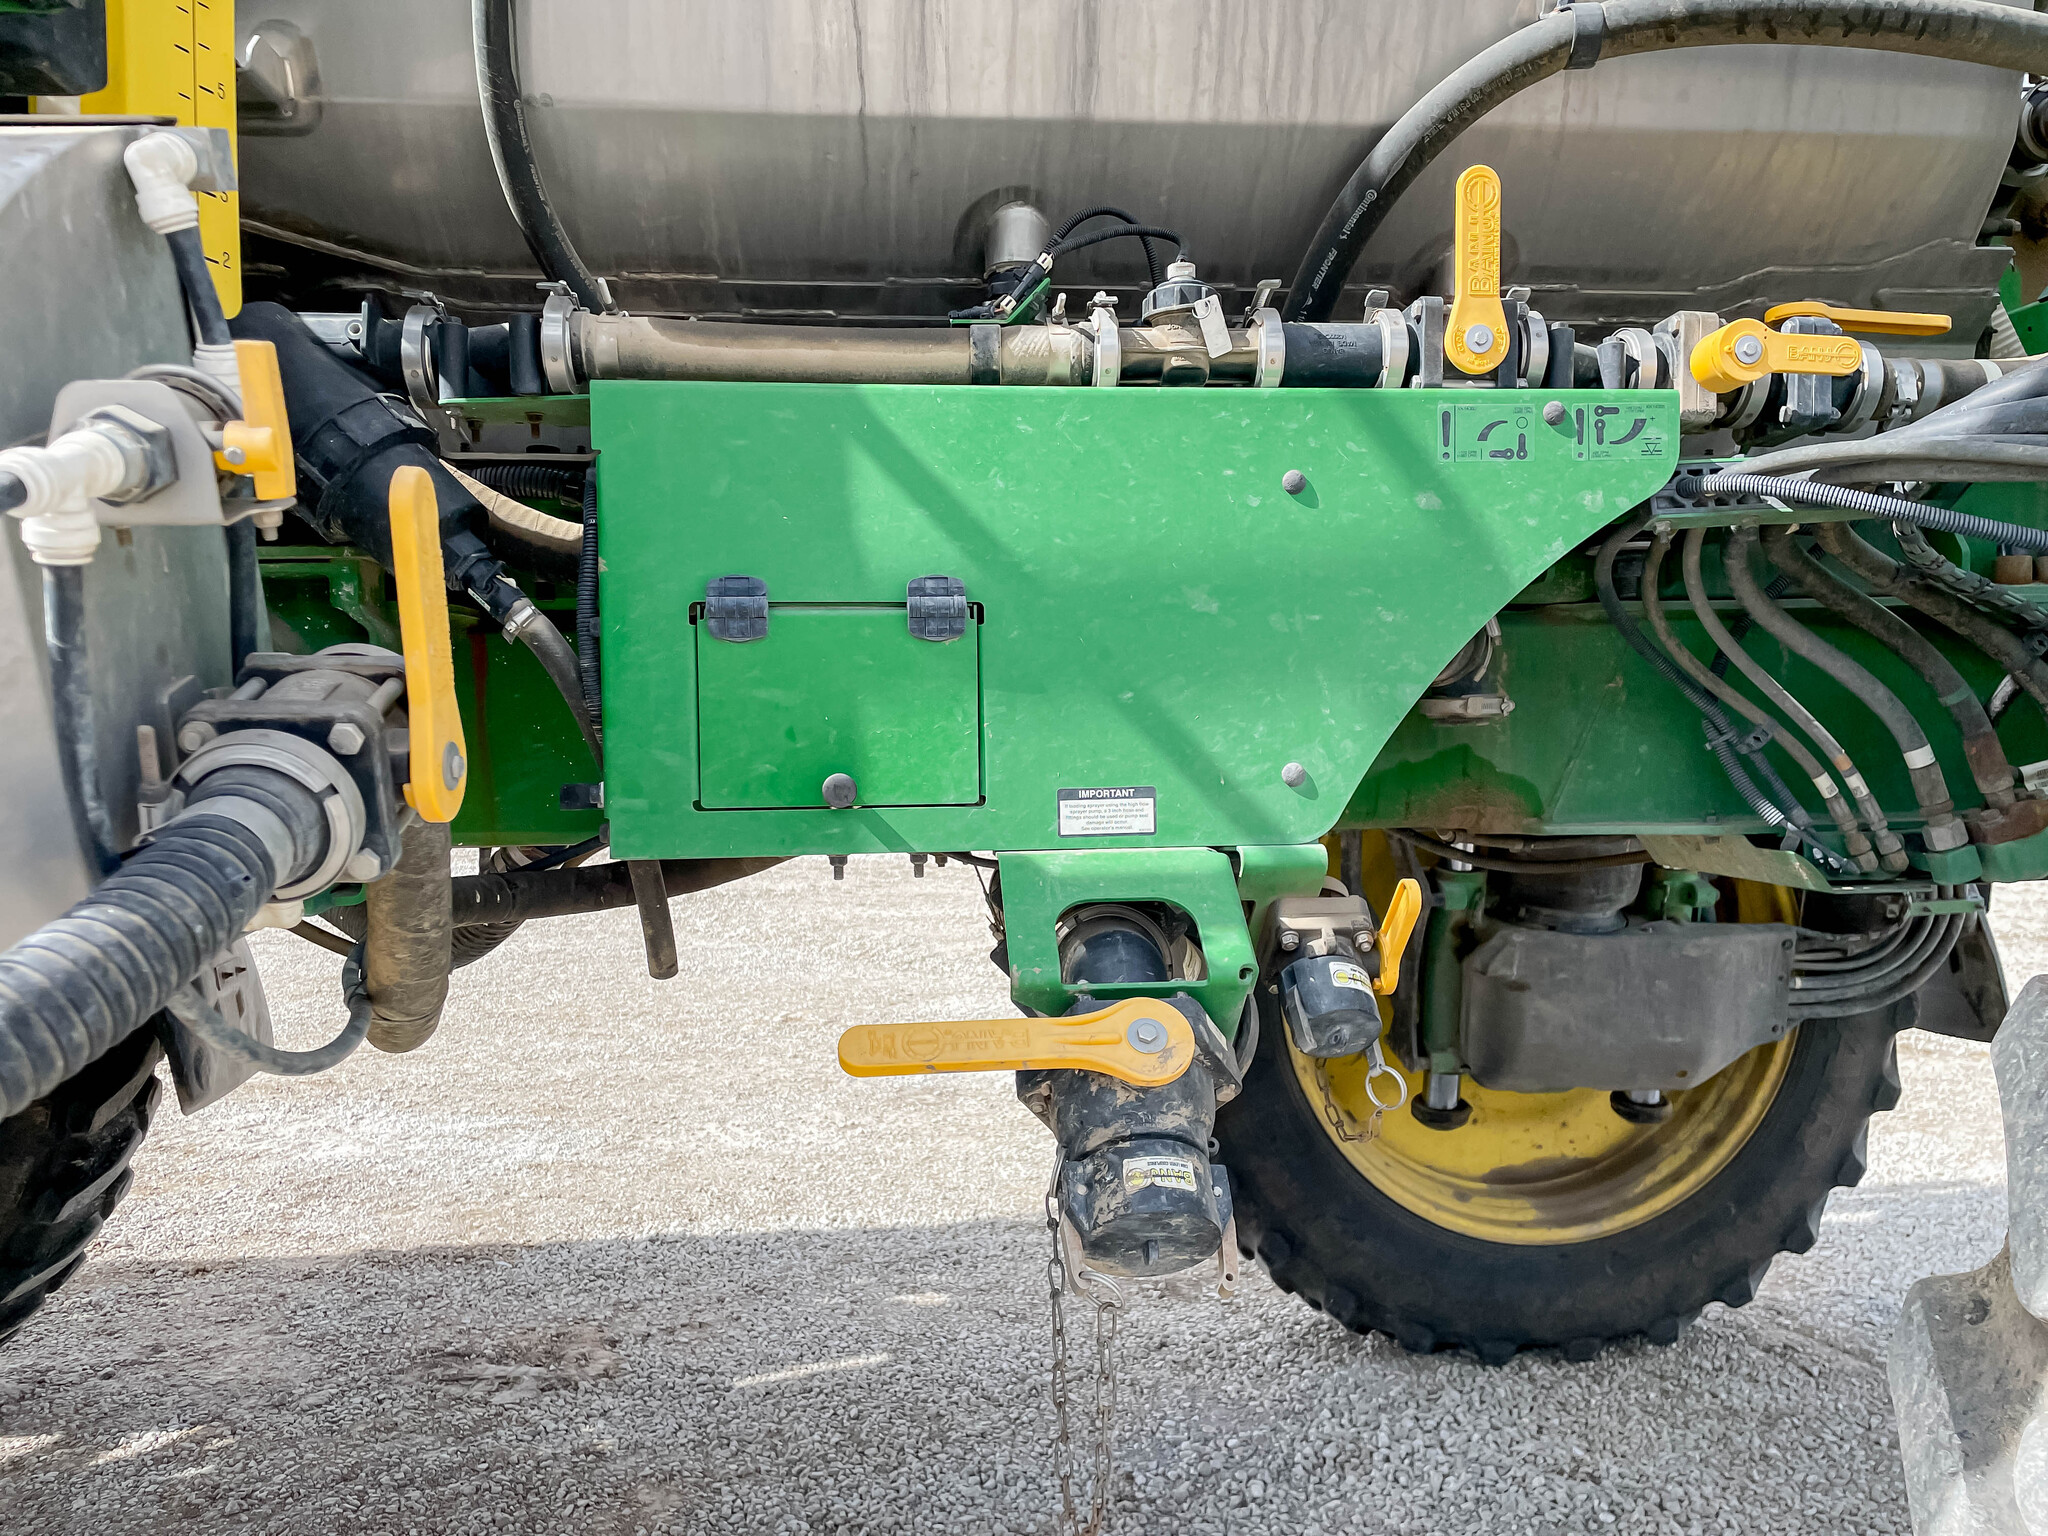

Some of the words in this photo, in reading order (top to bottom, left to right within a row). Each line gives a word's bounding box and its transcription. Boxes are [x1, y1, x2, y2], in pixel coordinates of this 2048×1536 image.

[217, 82, 226, 100] 5
[1460, 99, 1471, 113] PSI
[1342, 189, 1377, 235] Continental
[222, 252, 231, 269] 2
[1312, 247, 1338, 290] FRONTIER
[1078, 789, 1135, 798] IMPORTANT
